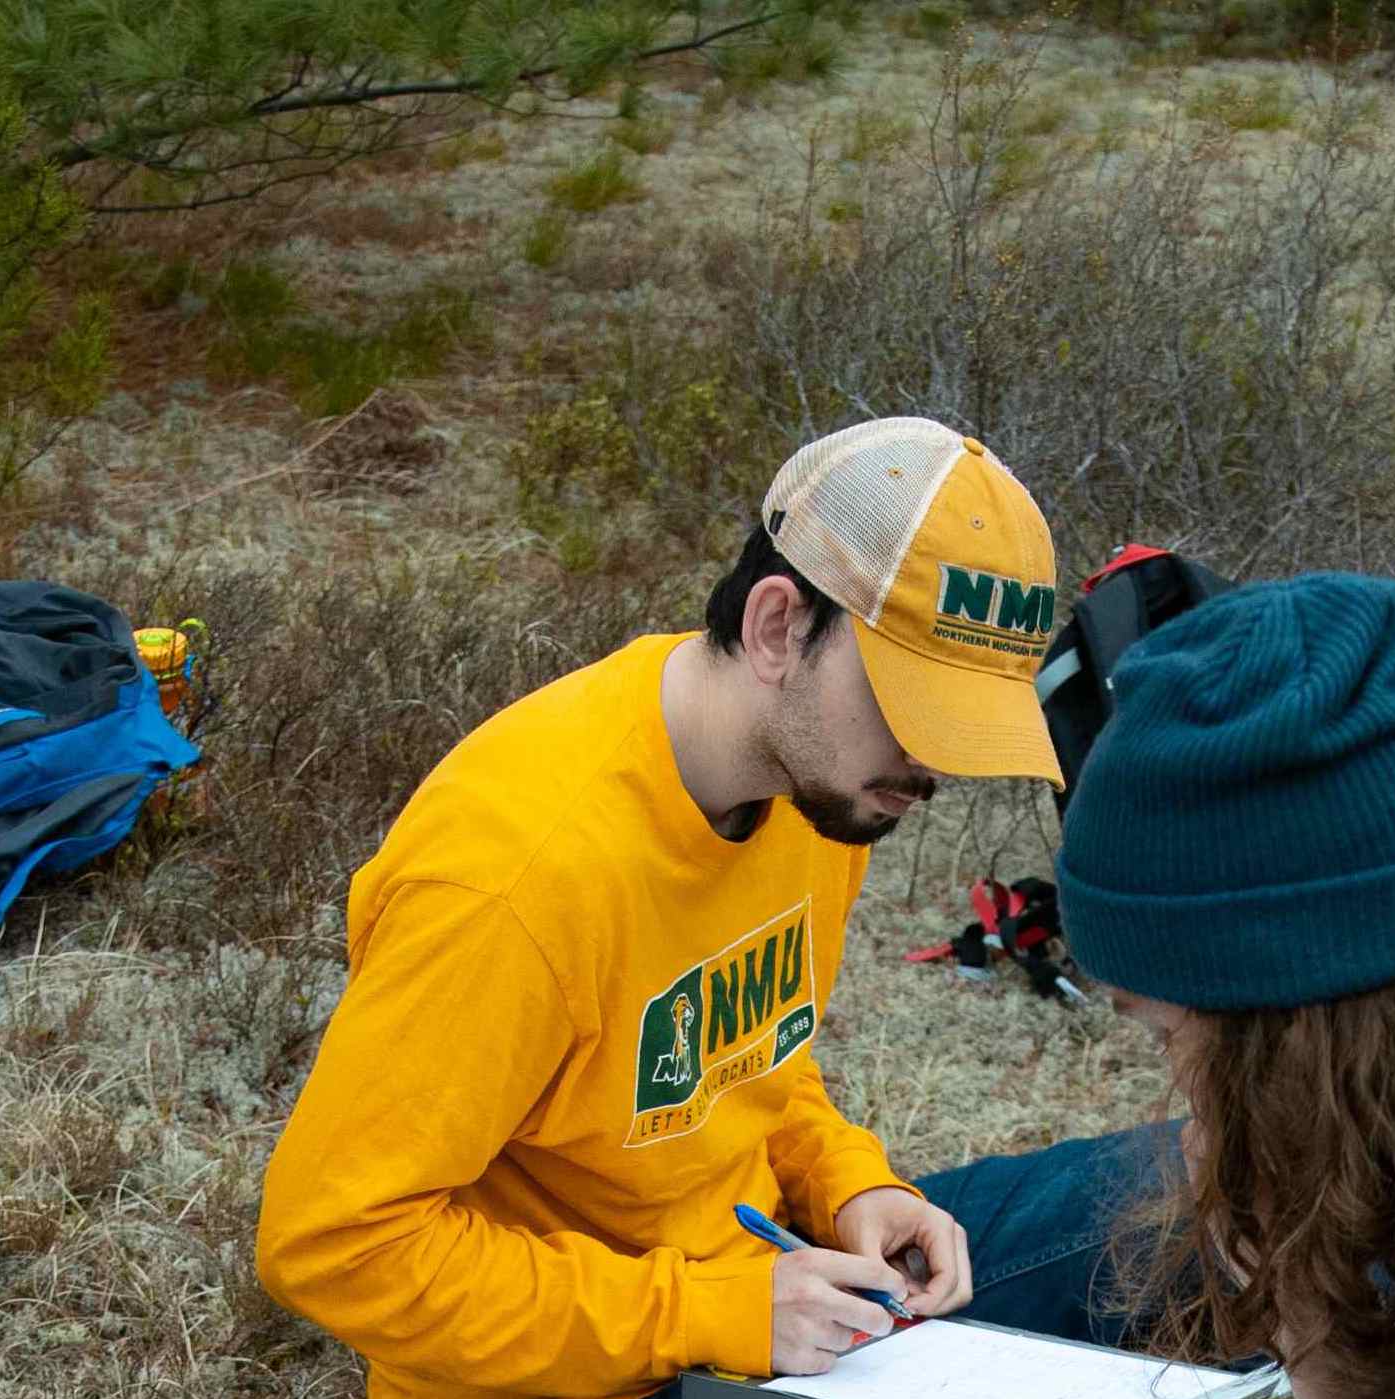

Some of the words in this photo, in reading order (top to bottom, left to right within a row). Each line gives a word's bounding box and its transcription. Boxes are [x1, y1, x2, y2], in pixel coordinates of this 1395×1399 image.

[933, 626, 990, 648] NORTHERN
[708, 913, 805, 1055] NMU
[641, 1108, 692, 1136] LET'S
